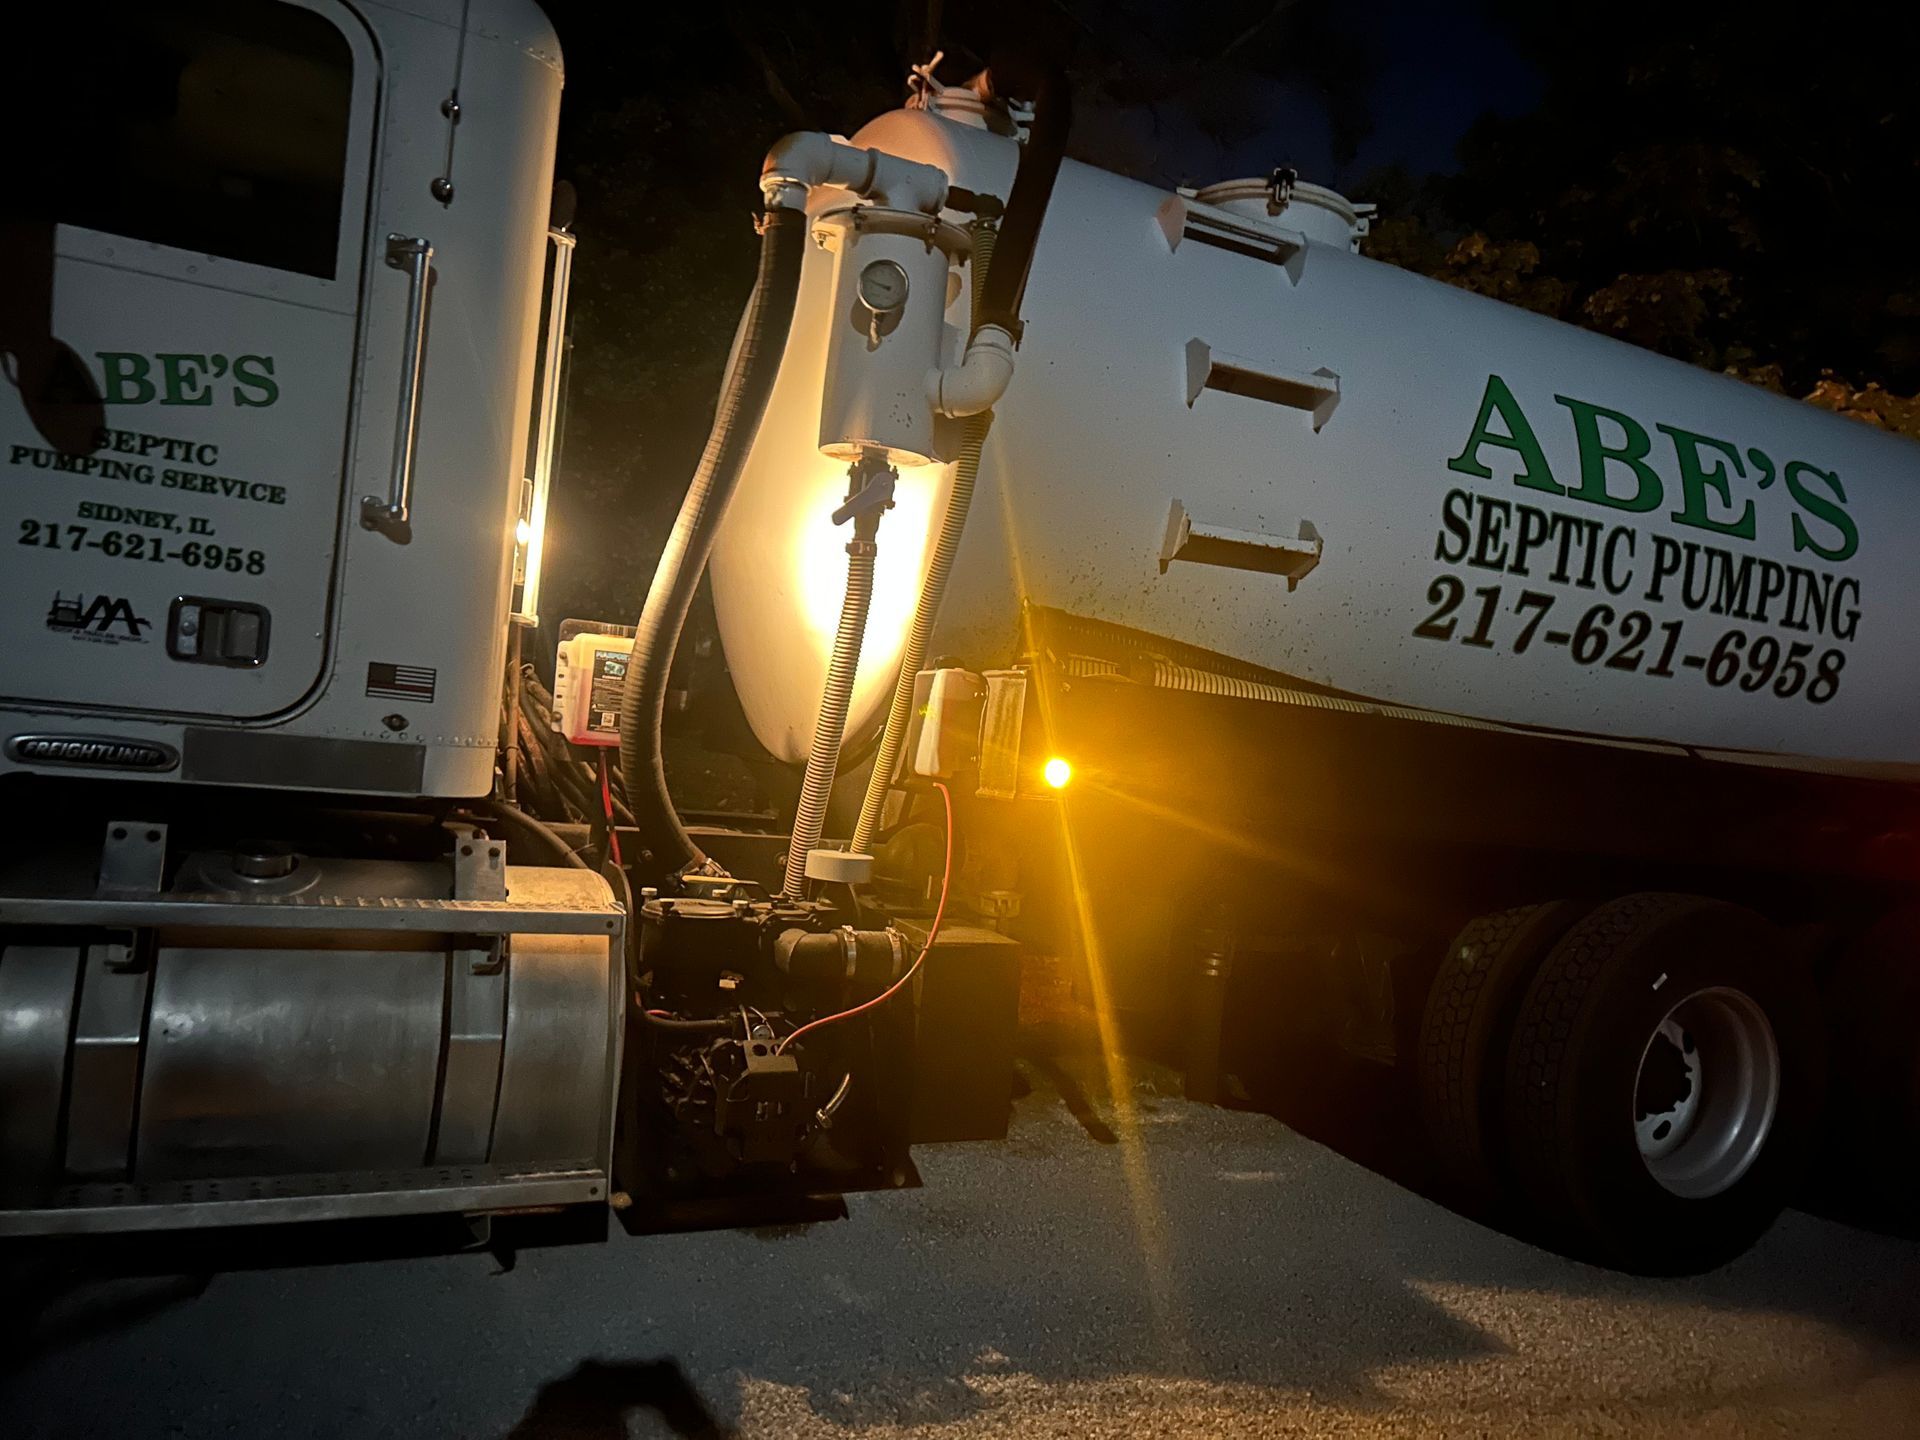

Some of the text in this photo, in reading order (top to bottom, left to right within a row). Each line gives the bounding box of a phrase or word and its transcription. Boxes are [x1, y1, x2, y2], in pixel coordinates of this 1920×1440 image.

[9, 445, 286, 505] PUMPING SERVICE
[94, 428, 219, 466] SEPTIC
[1447, 373, 1861, 562] ABE'S
[18, 519, 266, 575] 217-621-6958
[77, 501, 216, 536] SIDNEY, IL
[1435, 487, 1863, 642] SEPTIC PUMPING
[1412, 574, 1847, 704] 217-621-6958
[23, 740, 161, 765] FREIGHTLINER
